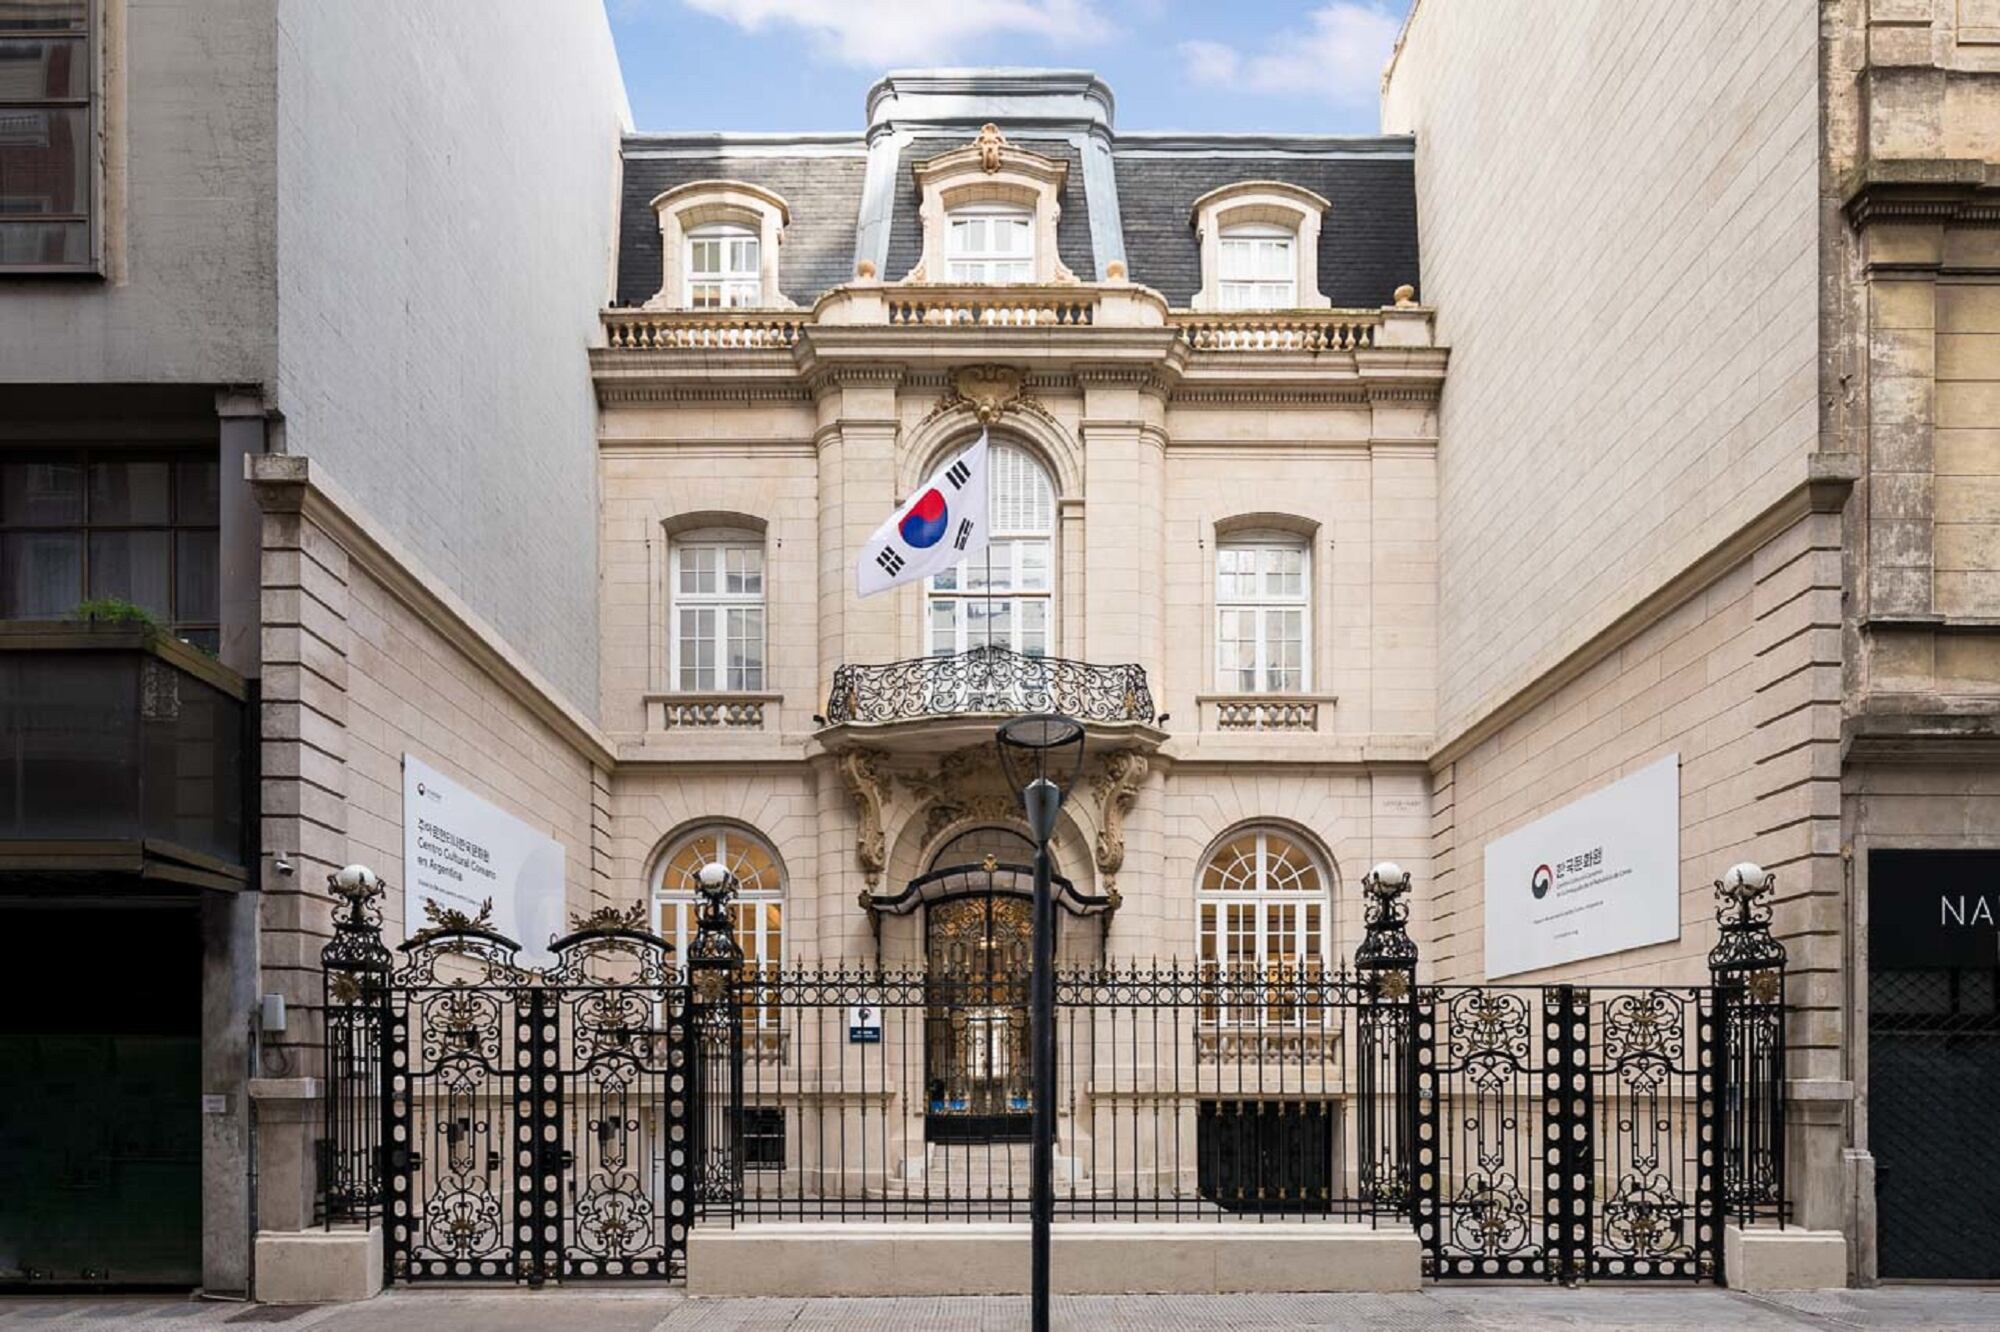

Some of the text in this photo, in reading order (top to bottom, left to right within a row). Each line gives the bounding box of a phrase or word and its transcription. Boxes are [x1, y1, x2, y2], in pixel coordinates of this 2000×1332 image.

[417, 836, 442, 857] Centro
[444, 848, 470, 868] Cultural
[1556, 846, 1603, 878] 한국문화원
[417, 856, 463, 882] en Argentina
[1942, 895, 2000, 925] NA
